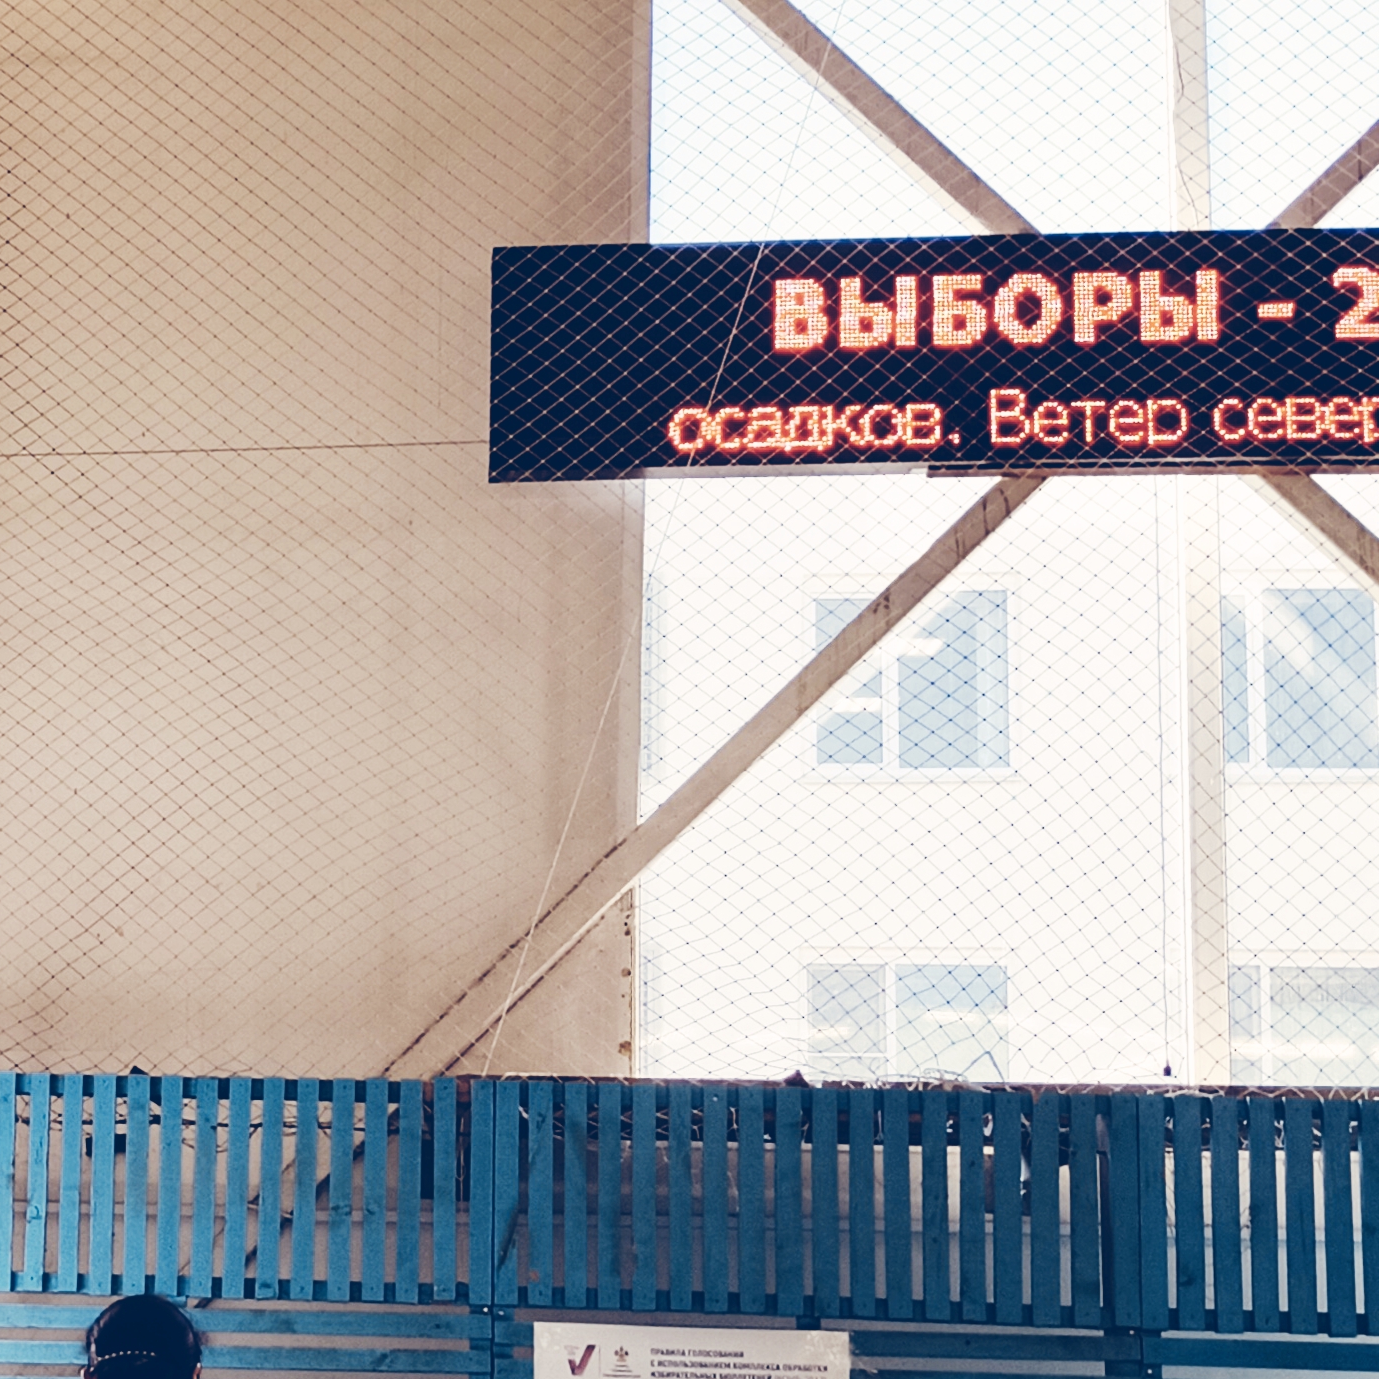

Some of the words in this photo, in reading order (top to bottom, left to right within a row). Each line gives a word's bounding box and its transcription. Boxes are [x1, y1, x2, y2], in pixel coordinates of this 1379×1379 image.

[773, 268, 1220, 350] ВЫБОРЫ
[669, 403, 961, 451] осадков.
[988, 388, 1188, 446] Ветер
